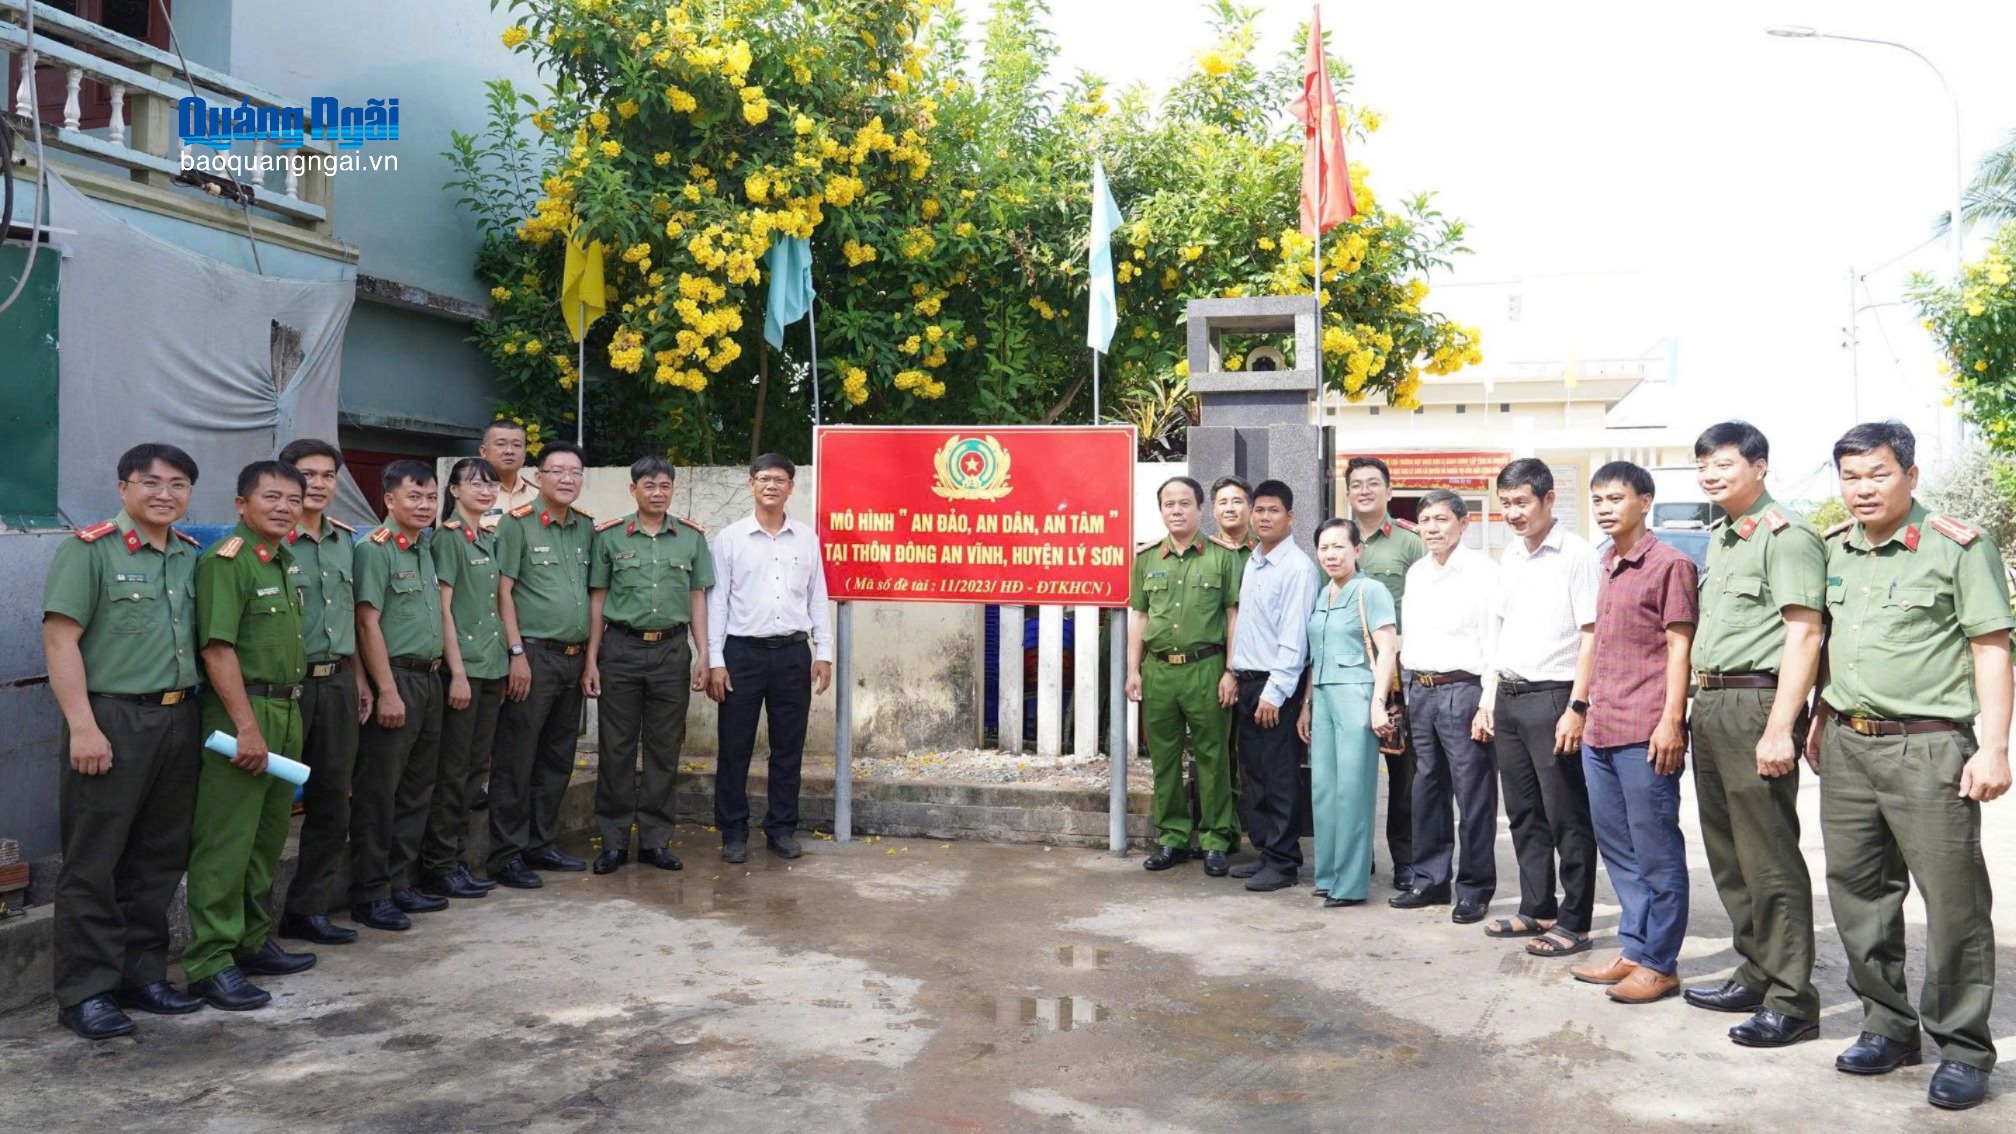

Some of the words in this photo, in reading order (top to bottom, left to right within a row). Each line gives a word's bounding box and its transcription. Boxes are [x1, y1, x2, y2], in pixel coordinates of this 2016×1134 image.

[830, 508, 854, 531] MÔ
[858, 509, 895, 532] HÌNH
[911, 513, 933, 532] AN
[937, 508, 972, 535] ĐẢO,
[976, 514, 998, 533] AN
[1002, 510, 1039, 536] DÂN,
[1043, 514, 1066, 534] AN
[1070, 510, 1105, 534] TÂM
[824, 543, 848, 566] TẠI
[851, 540, 891, 563] THÔN
[895, 541, 937, 563] ĐÔNG
[941, 545, 963, 564] AN
[967, 542, 1008, 567] VĨNH,
[1012, 542, 1064, 569] HUYỆN
[1068, 543, 1087, 566] LÝ
[1091, 545, 1124, 566] SƠN
[853, 577, 874, 590] Mã
[877, 577, 893, 591] số
[893, 577, 909, 591] đề
[911, 578, 930, 592] tài
[1000, 580, 1024, 594] HĐ
[1036, 580, 1104, 594] ĐTKHCN
